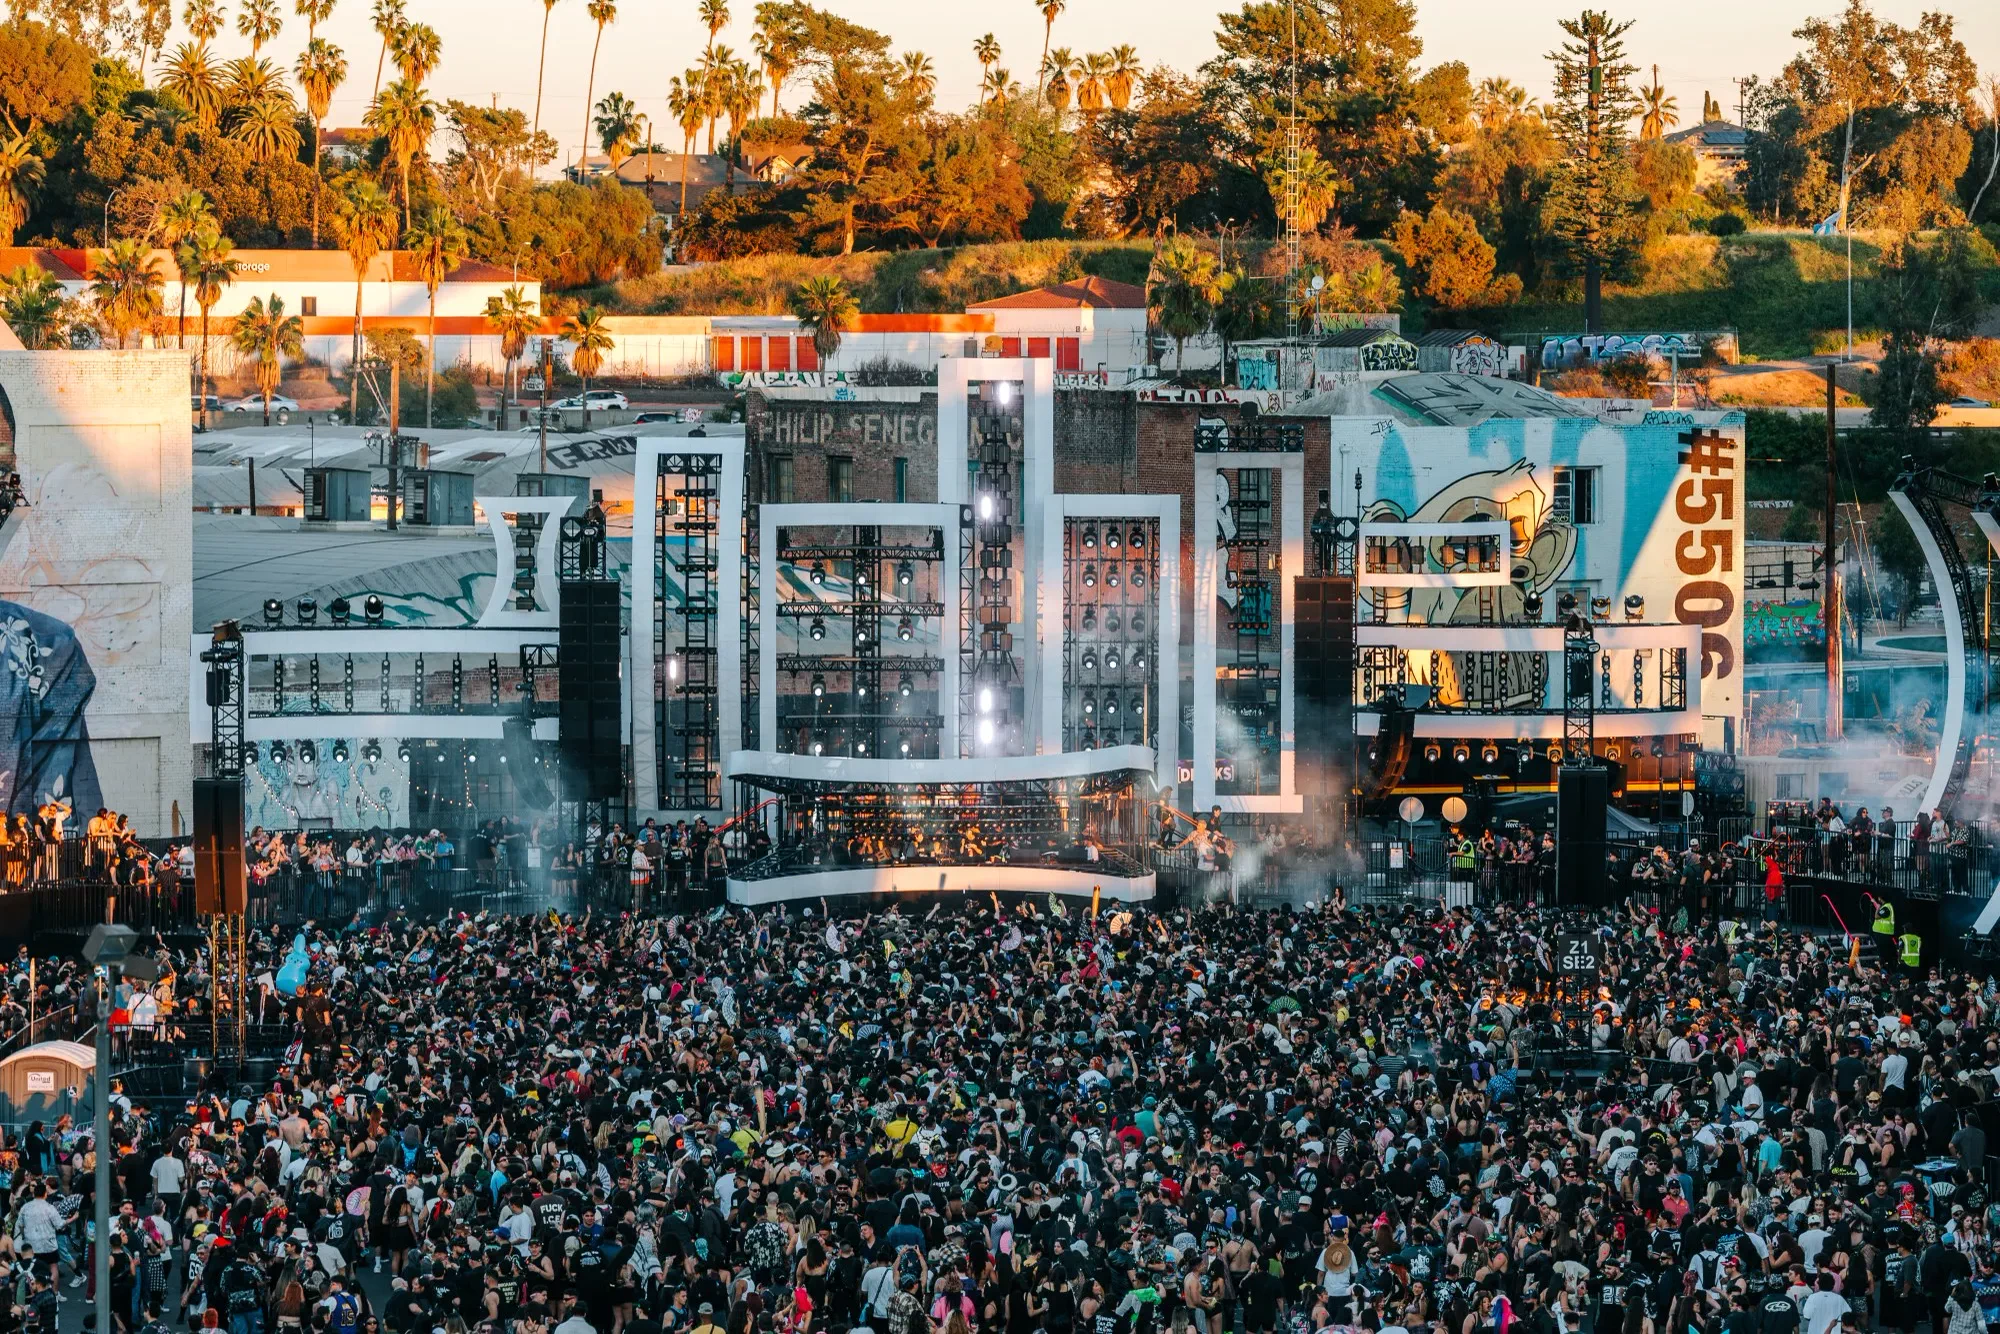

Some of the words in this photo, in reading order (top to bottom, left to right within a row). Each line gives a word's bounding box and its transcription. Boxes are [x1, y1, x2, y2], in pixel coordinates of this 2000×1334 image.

[755, 411, 834, 444] PHILIP
[849, 413, 937, 445] SENEG
[1177, 765, 1235, 784] [DKS]
[1569, 940, 1588, 955] Z1
[1562, 955, 1595, 970] SE2
[540, 1203, 563, 1214] FUCK
